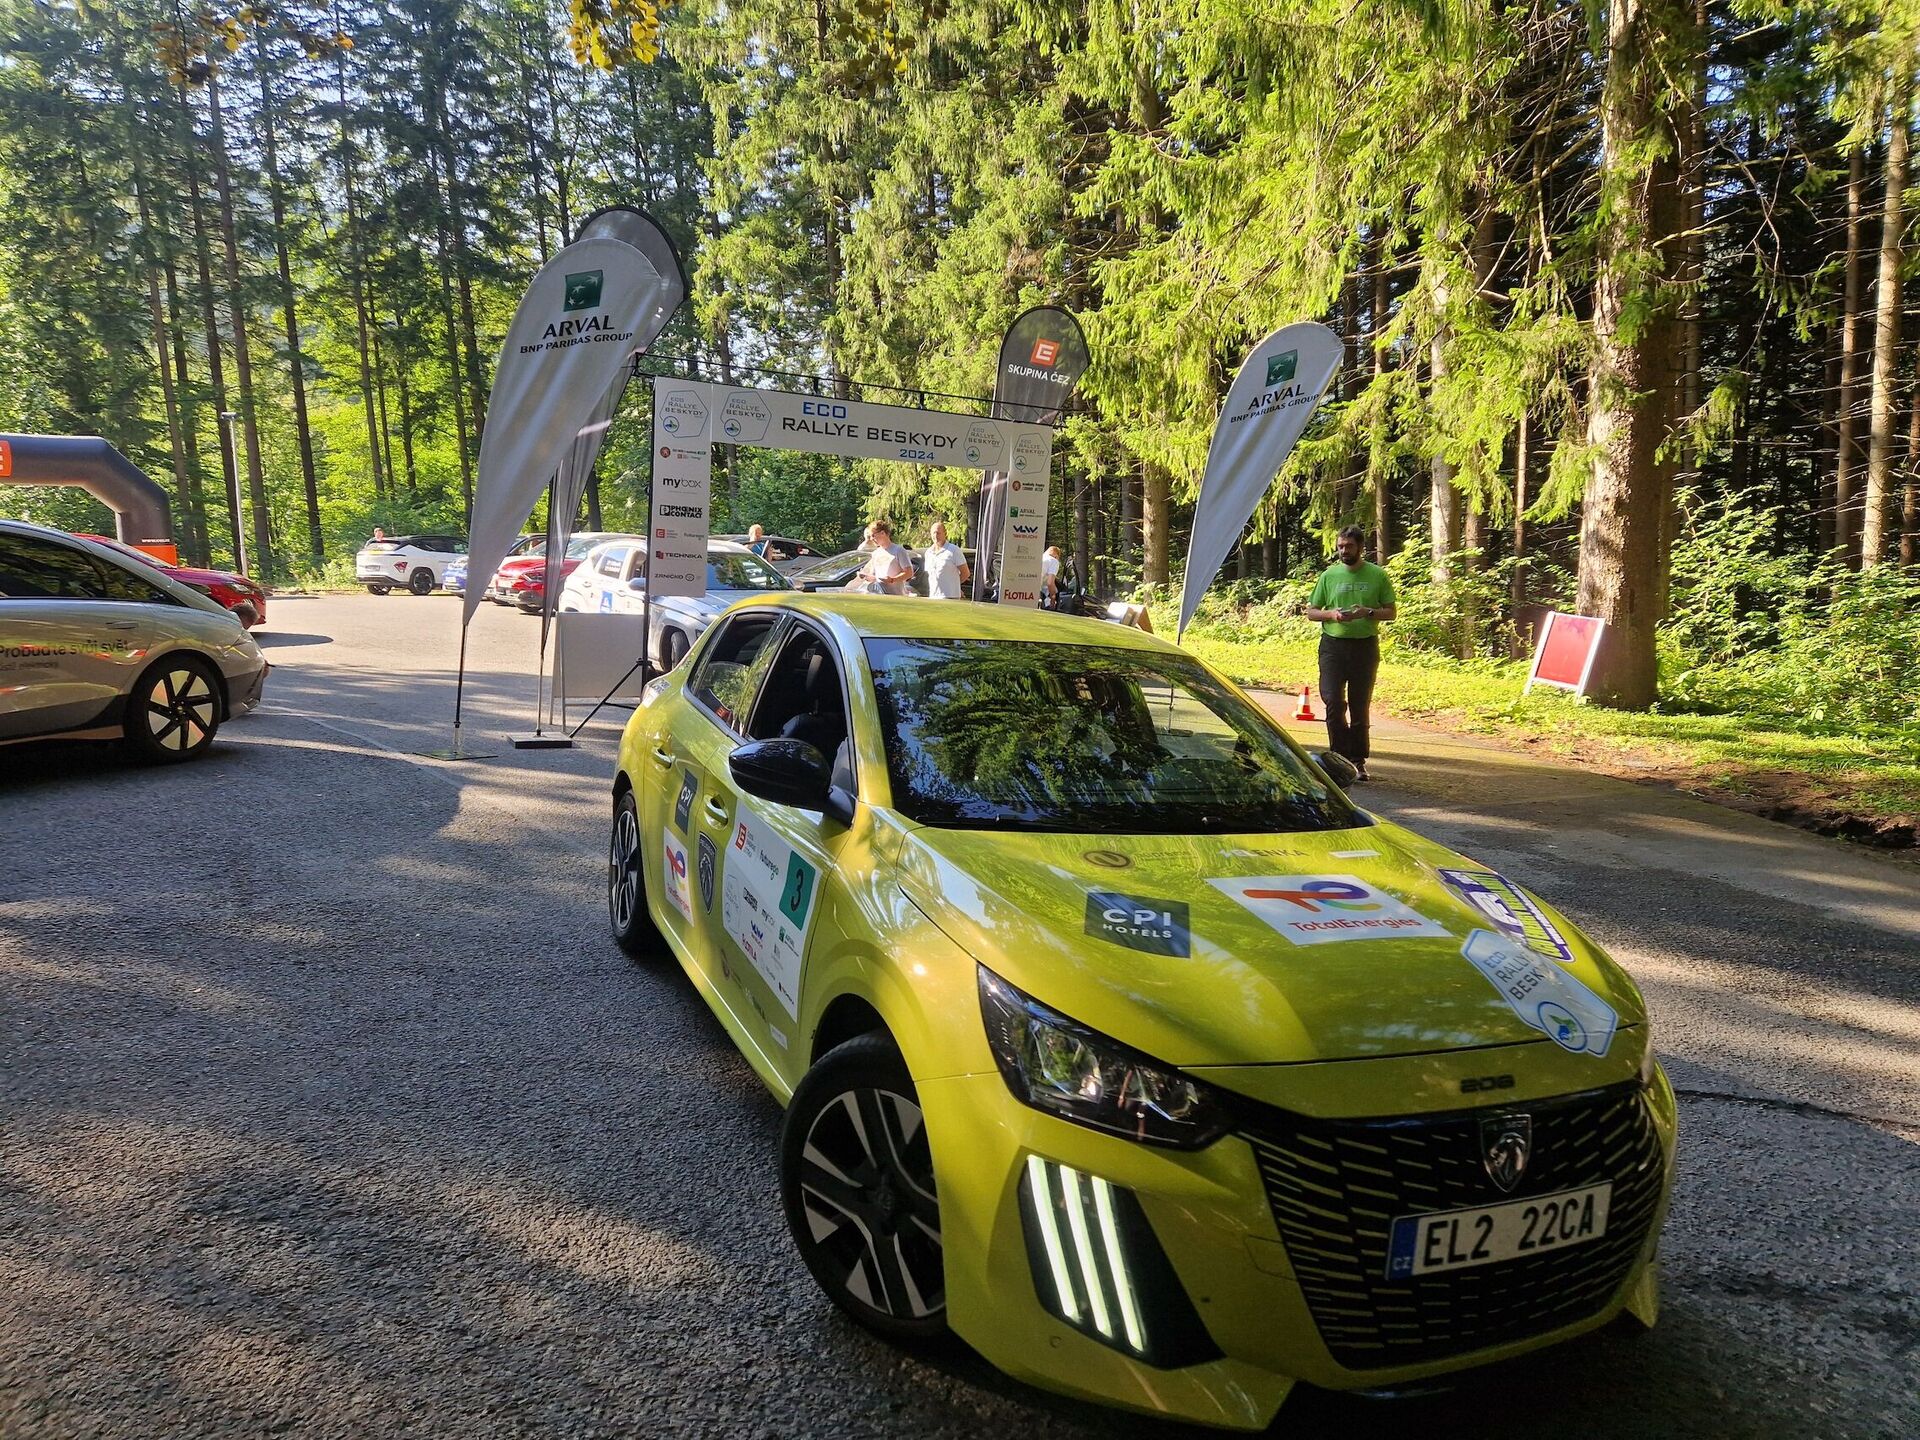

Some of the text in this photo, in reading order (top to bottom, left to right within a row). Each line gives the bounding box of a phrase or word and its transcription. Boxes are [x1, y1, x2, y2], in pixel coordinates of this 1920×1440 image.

[543, 315, 615, 340] ARVAL
[520, 332, 633, 354] BNP PARIBAS GROUP
[1007, 363, 1071, 386] SKUPINA ČEZ
[1247, 384, 1306, 411] ARVAL
[665, 407, 704, 416] BESKYDY
[726, 409, 766, 418] BESKYDY
[729, 403, 760, 411] RALLYE
[803, 402, 847, 419] ECO
[1230, 394, 1320, 424] BNP PARIBAS GROUP
[782, 417, 958, 449] RALLYE BESKYDY
[899, 449, 935, 461] 2024
[662, 475, 702, 488] mybox
[670, 511, 703, 519] CONTACT
[665, 552, 703, 560] TECHNIKA
[1004, 589, 1035, 601] FLOTILA
[101, 639, 129, 653] svět
[681, 786, 693, 807] CPI
[791, 868, 804, 912] 3
[1103, 908, 1172, 926] CPI
[1288, 917, 1422, 932] TotalEnergies
[1103, 924, 1172, 939] HOTELS
[1483, 951, 1507, 969] ECO
[1423, 1194, 1594, 1268] EL2 22CA
[1392, 1255, 1413, 1272] CZ
